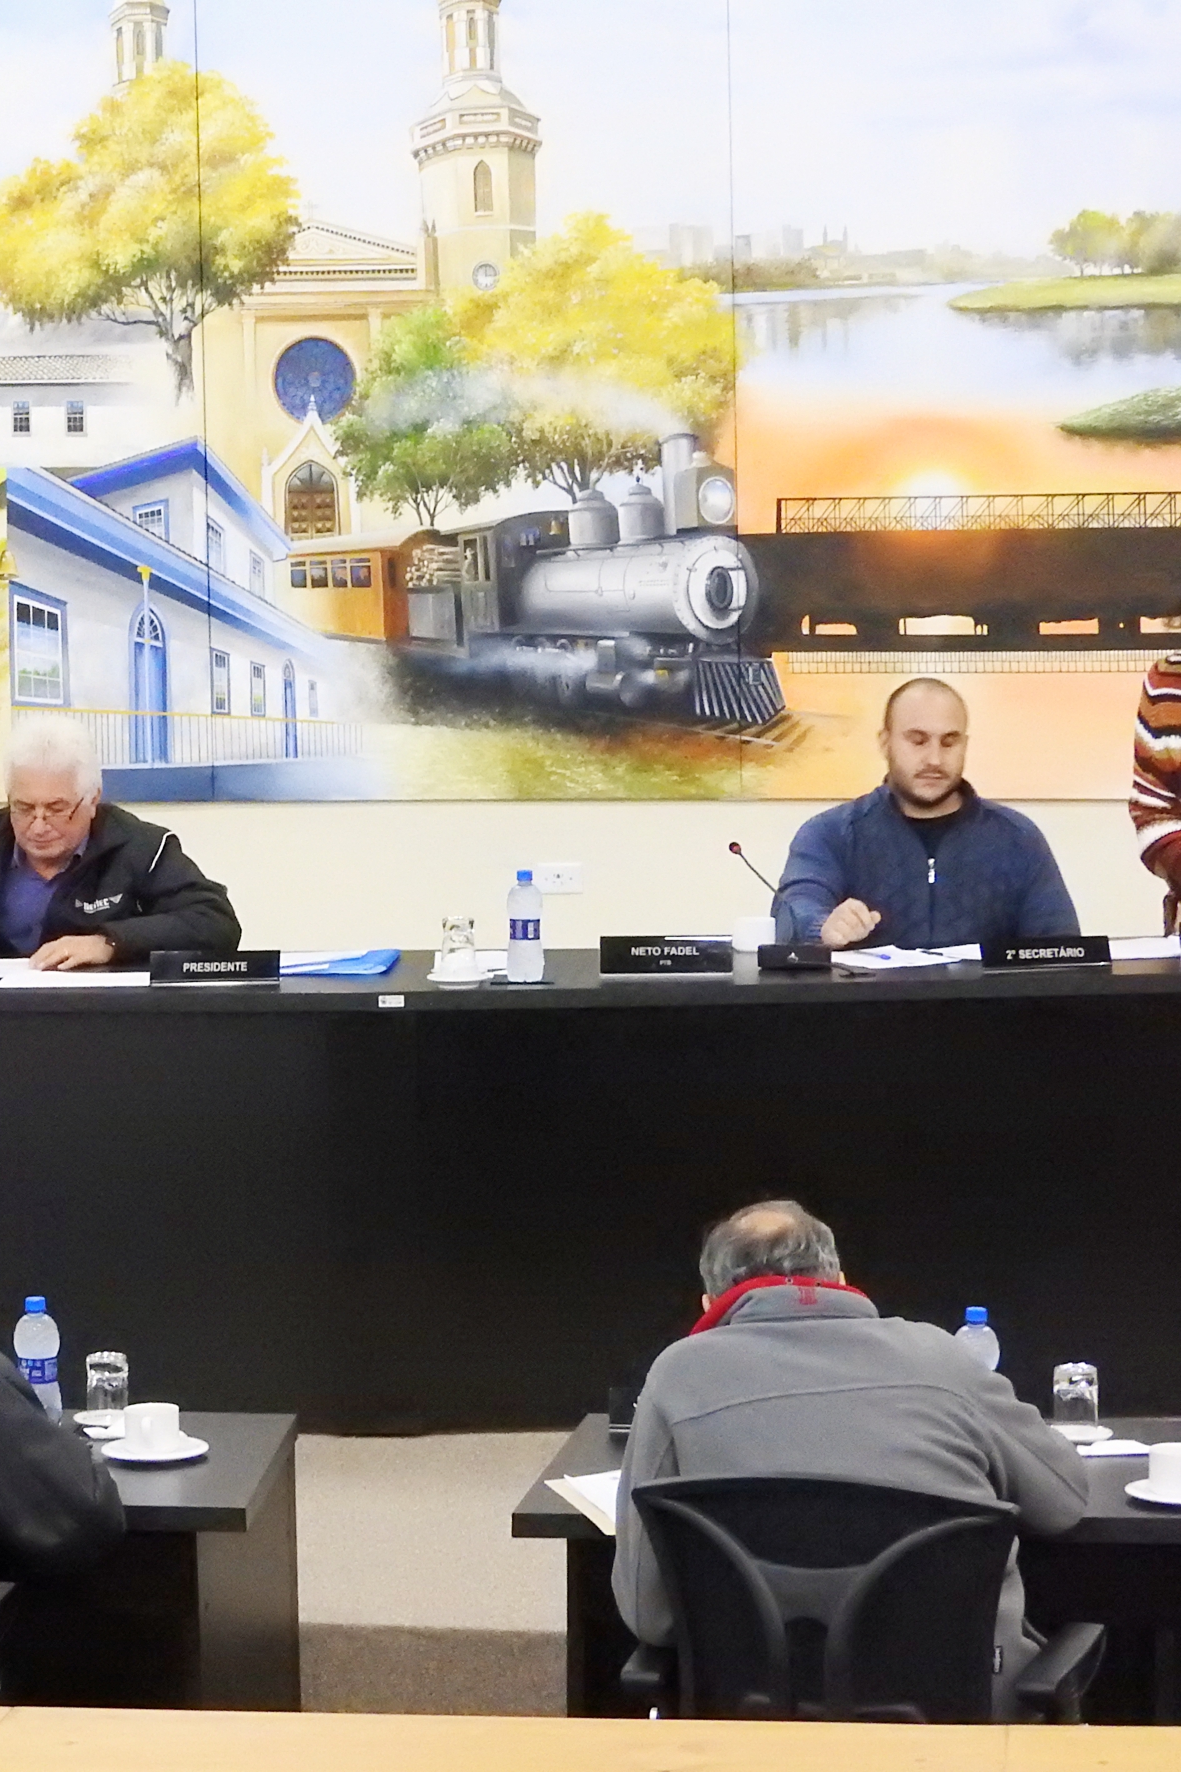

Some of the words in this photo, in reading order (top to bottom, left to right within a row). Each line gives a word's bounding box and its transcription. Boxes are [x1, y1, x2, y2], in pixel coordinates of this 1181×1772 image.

[631, 946, 661, 956] NETO
[664, 946, 700, 956] FADEL
[1019, 946, 1085, 959] SECRETÁRIO
[182, 961, 248, 972] PRESIDENTE
